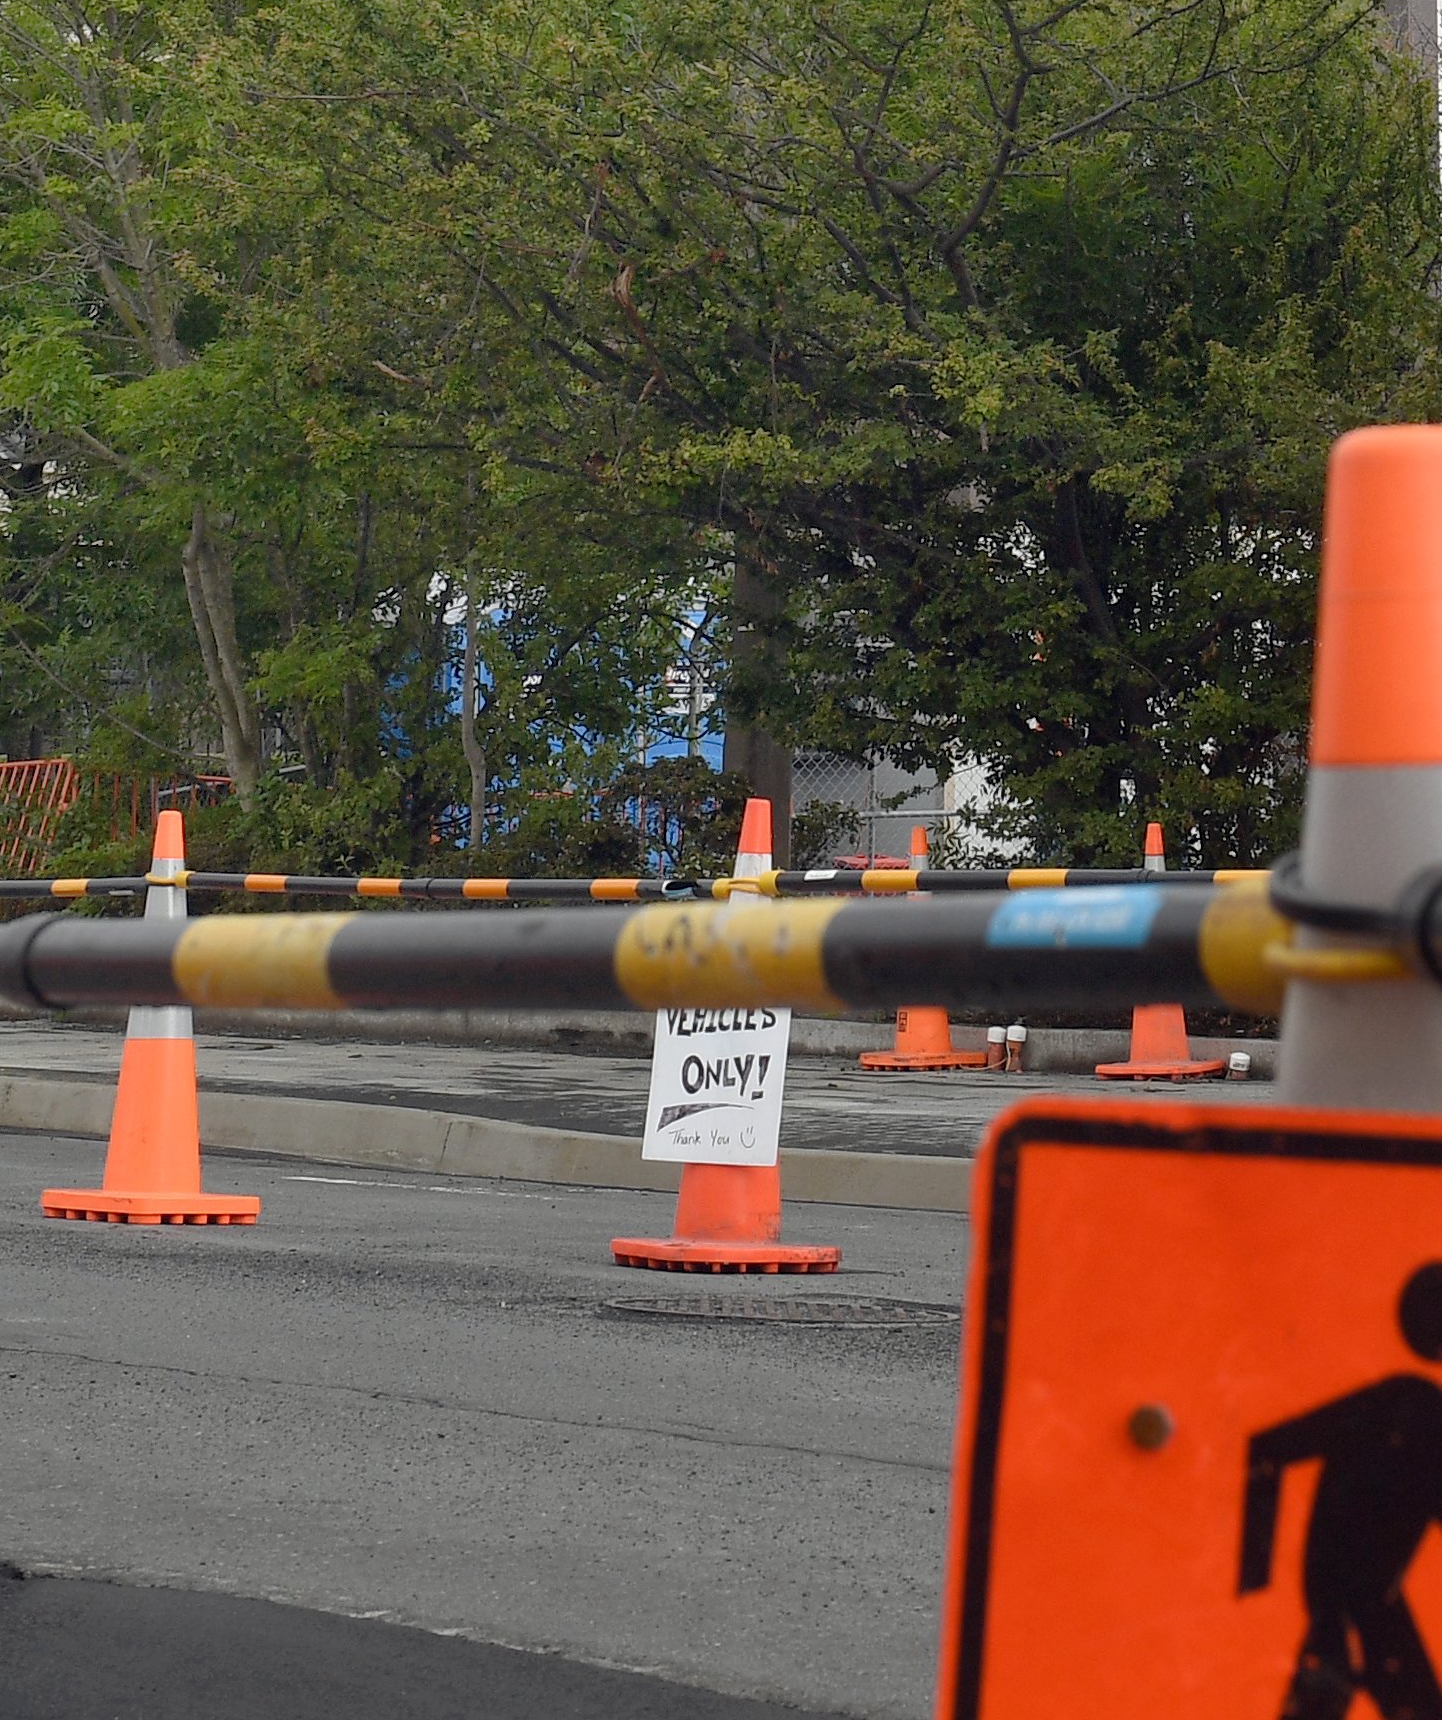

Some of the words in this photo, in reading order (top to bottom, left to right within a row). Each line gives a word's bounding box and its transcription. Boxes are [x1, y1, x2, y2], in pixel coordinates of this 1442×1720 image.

[666, 1008, 777, 1037] VEHICLES
[681, 1054, 771, 1101] ONLY!
[669, 1128, 702, 1146] Thank
[710, 1129, 731, 1148] You
